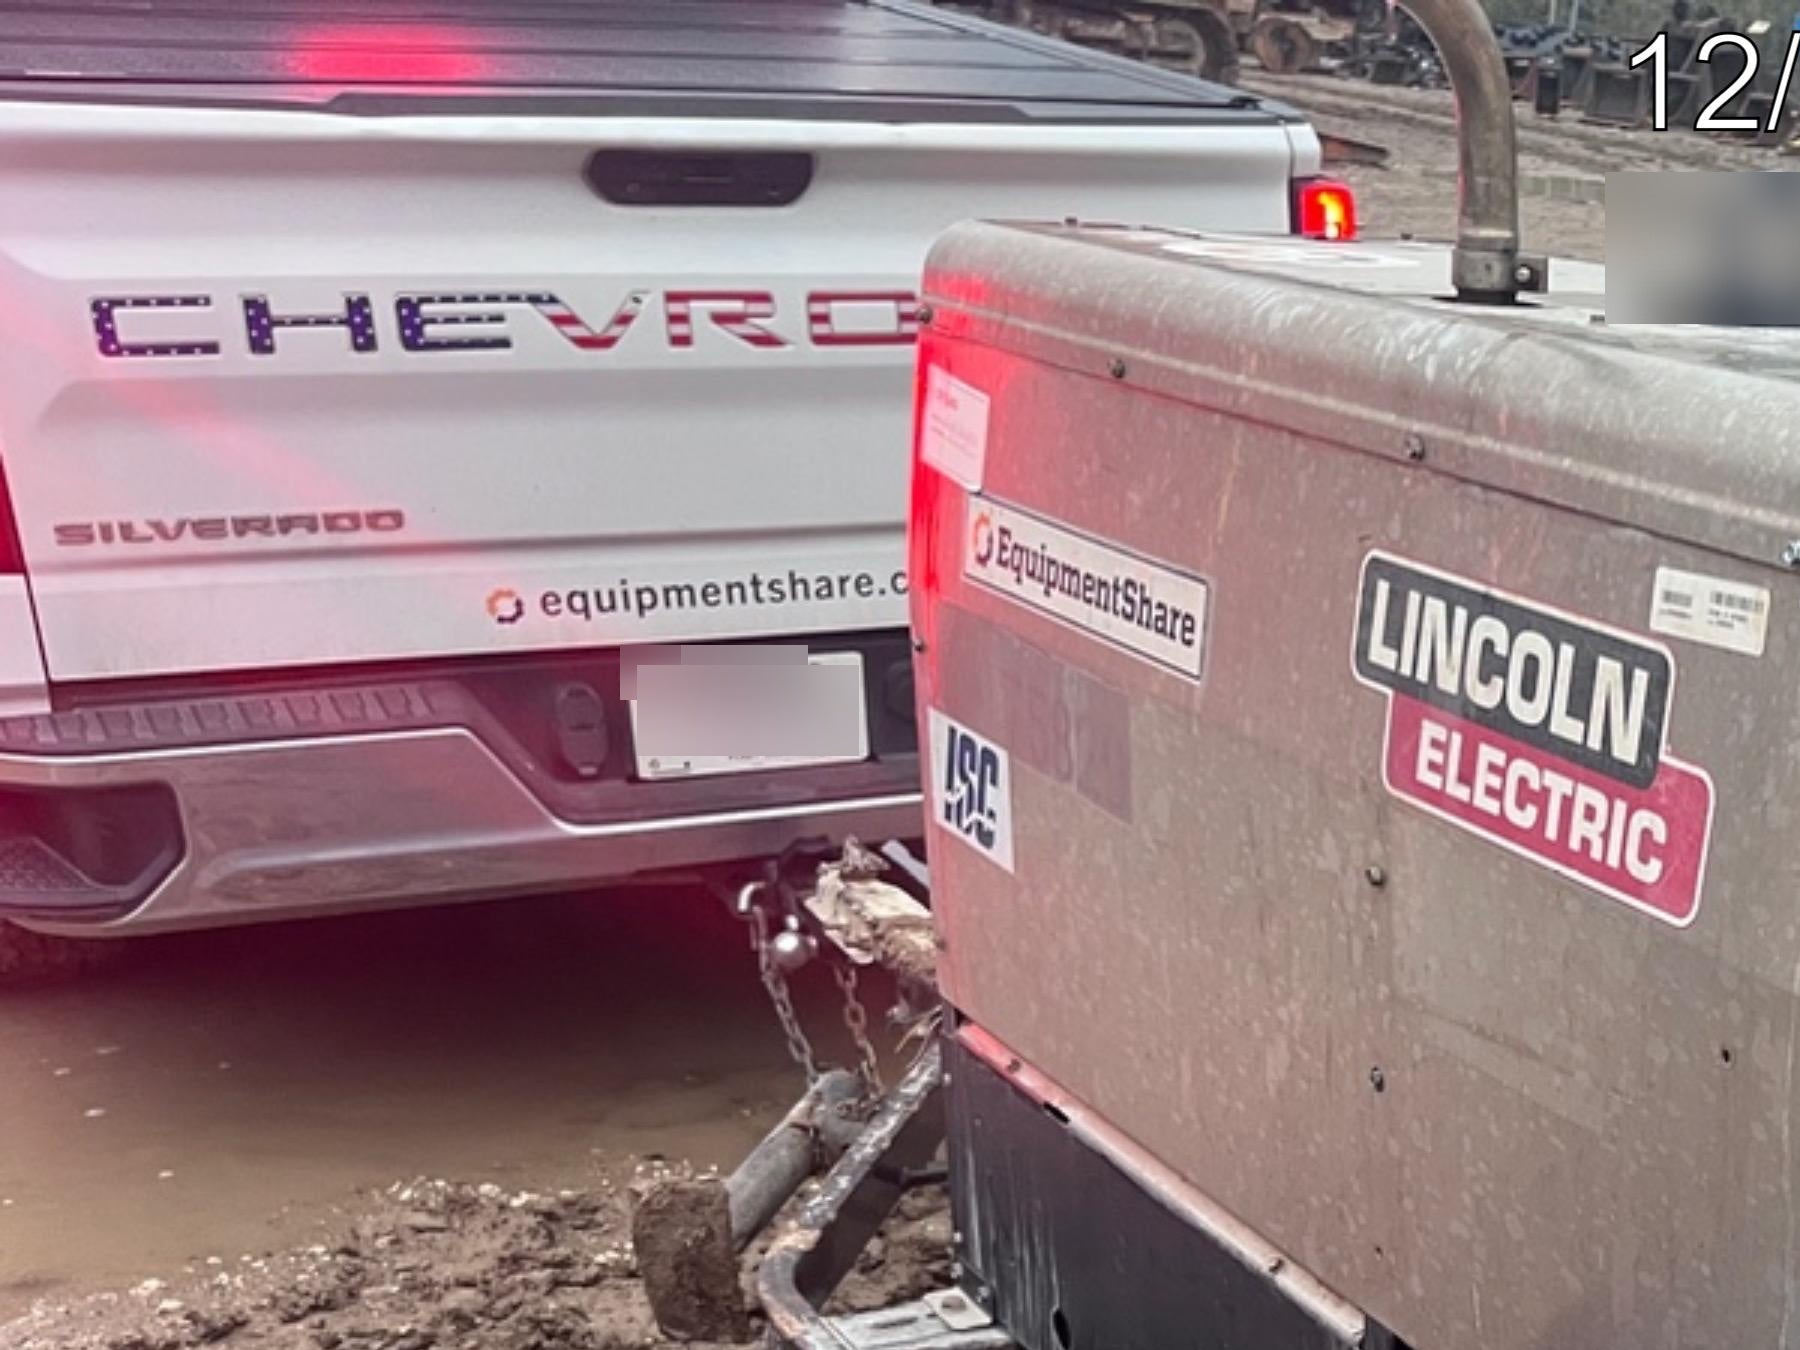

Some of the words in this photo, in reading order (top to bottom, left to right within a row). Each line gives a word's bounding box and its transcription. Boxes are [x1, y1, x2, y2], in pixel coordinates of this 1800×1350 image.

[54, 508, 406, 547] SILVERADO
[995, 524, 1196, 650] EquipmentShare
[1366, 577, 1650, 768] LINCOLN
[1415, 717, 1668, 885] ELECTRIC
